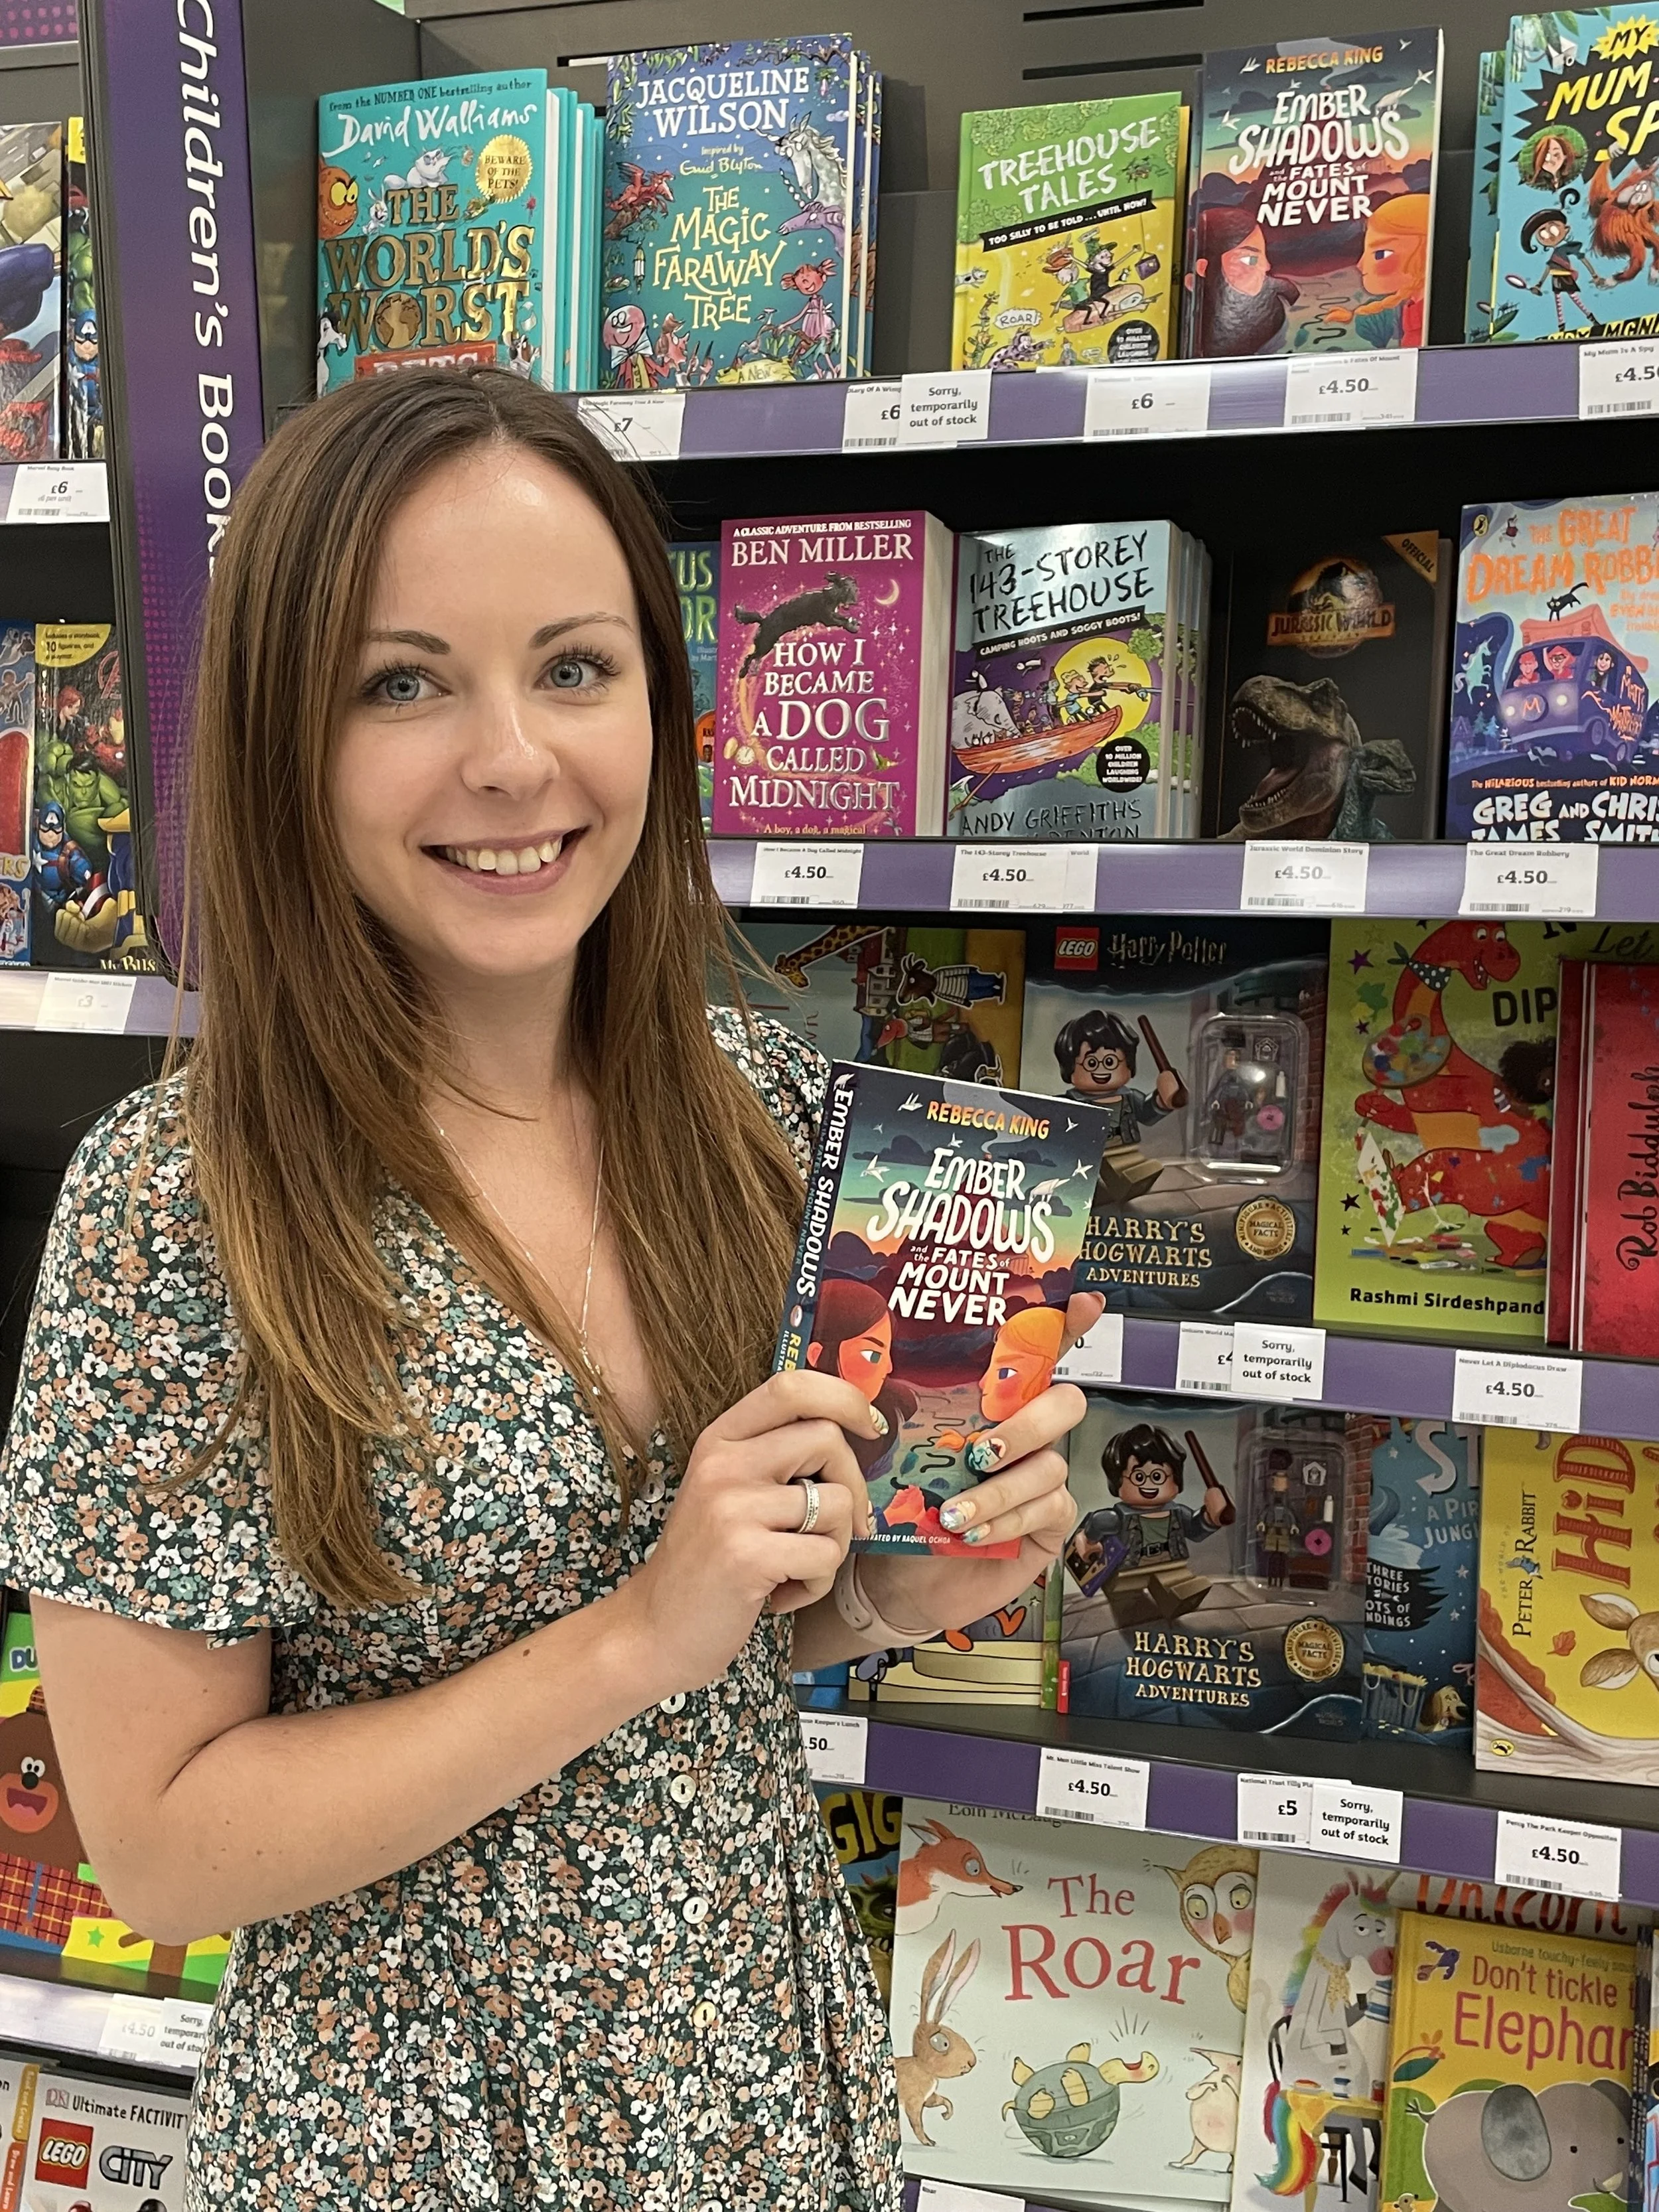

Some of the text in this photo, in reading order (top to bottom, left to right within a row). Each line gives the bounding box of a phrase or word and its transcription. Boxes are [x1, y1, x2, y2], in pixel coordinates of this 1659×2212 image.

[1611, 25, 1651, 52] MY
[1265, 45, 1384, 74] REBECCA KING
[636, 67, 810, 109] JACQUELINE
[1546, 60, 1652, 122] MUM
[653, 98, 790, 139] WILSON
[1272, 84, 1372, 125] EMBER
[322, 100, 538, 157] David Walliams
[978, 117, 1161, 190] TREEHOUSE
[1229, 111, 1409, 175] SHADOWS
[177, 0, 230, 348] Children's
[485, 155, 527, 165] BEWARE
[487, 167, 521, 177] OF THE
[680, 155, 764, 175] Enid Blyton
[703, 185, 740, 212] THE
[1019, 163, 1118, 214] TALES
[1262, 175, 1369, 204] MOUNT
[387, 184, 459, 227] THE
[1256, 195, 1374, 227] NEVER
[671, 206, 770, 254] MAGIC
[324, 220, 536, 292] WORLD'S
[652, 240, 788, 297] FARAWAY
[327, 280, 530, 356] WORST
[684, 291, 752, 331] TREE
[749, 368, 772, 382] NEW
[1319, 378, 1370, 395] £4.50
[910, 399, 978, 413] temporarily
[928, 387, 962, 397] Sorry,
[1131, 392, 1154, 410] £6
[614, 417, 634, 432] £7
[910, 414, 977, 427] out of stock
[51, 481, 69, 494] £6
[733, 519, 911, 538] A CLASSIC ADVENTURE FROM BESTSELLING
[1529, 523, 1553, 546] THE
[1558, 505, 1638, 548] GREAT
[731, 534, 914, 566] BEN MILLER
[984, 543, 1016, 564] THE
[1401, 538, 1435, 574] OFFICIAL
[970, 529, 1148, 604] 143-STOREY
[1467, 551, 1576, 605] DREAM
[972, 567, 1155, 634] TREEHOUSE
[980, 641, 1016, 656] CAMPING
[1050, 628, 1068, 640] AND
[1070, 621, 1103, 635] SOGGY
[1105, 612, 1141, 627] BOOTS!
[1271, 609, 1392, 636] JURASSIC WORLD
[773, 638, 867, 668] HOW I
[763, 670, 875, 697] BECAME
[752, 698, 890, 743] A DOG
[766, 746, 866, 773] CALLED
[729, 775, 901, 812] MIDNIGHT
[1473, 790, 1659, 825] GREG AND CHRI
[764, 824, 772, 834] A
[773, 824, 794, 836] boy,
[802, 824, 822, 836] dog,
[831, 823, 866, 836] magical
[962, 798, 1142, 837] ANDY GRIFFITHS
[784, 865, 828, 879] £4.50
[982, 868, 1027, 882] £4.50
[1275, 865, 1324, 880] £4.50
[1497, 870, 1548, 884] £4.50
[1057, 932, 1228, 966] LEGO Harry Potter
[926, 1100, 1050, 1140] REBECCA KING
[924, 1147, 1026, 1201] EMBER
[796, 1088, 854, 1298] EMBER SHADOWS
[866, 1181, 1055, 1264] SHADOWS
[1084, 1216, 1206, 1244] HARRY'S
[1249, 1220, 1284, 1229] MAGICAL
[1616, 1203, 1658, 1272] Rob
[914, 1252, 930, 1262] the
[930, 1246, 998, 1270] FATES
[999, 1258, 1011, 1268] of
[1078, 1240, 1213, 1268] HOGWARTS
[897, 1261, 1010, 1295] MOUNT
[1086, 1266, 1201, 1288] ADVENTURES
[887, 1286, 1007, 1327] NEVER
[1350, 1288, 1419, 1307] Rashmi
[1262, 1339, 1295, 1353] Sorry,
[1244, 1354, 1313, 1370] temporarily
[1503, 1361, 1545, 1370] Diplodocus
[1242, 1370, 1312, 1383] out of stock
[1486, 1381, 1536, 1398] £4.50
[1366, 1562, 1404, 1582] THREE
[1512, 1491, 1538, 1638] PETER RABBIT
[1134, 1631, 1256, 1663] HARRY'S
[1125, 1656, 1262, 1688] HOGWARTS
[1135, 1684, 1251, 1708] ADVENTURES
[1068, 1779, 1111, 1797] £4.50
[1278, 1800, 1298, 1816] £5
[1339, 1799, 1374, 1814] Sorry,
[1322, 1812, 1390, 1832] temporarily
[1557, 1828, 1582, 1836] Keeper
[1321, 1828, 1389, 1846] out of stock
[1532, 1846, 1580, 1865] £4.50
[1047, 1873, 1135, 1918] The
[1001, 1923, 1201, 2004] Roar
[1472, 1955, 1538, 1995] Don't
[1546, 1964, 1619, 2010] tickle
[41, 2138, 88, 2169] LEGO
